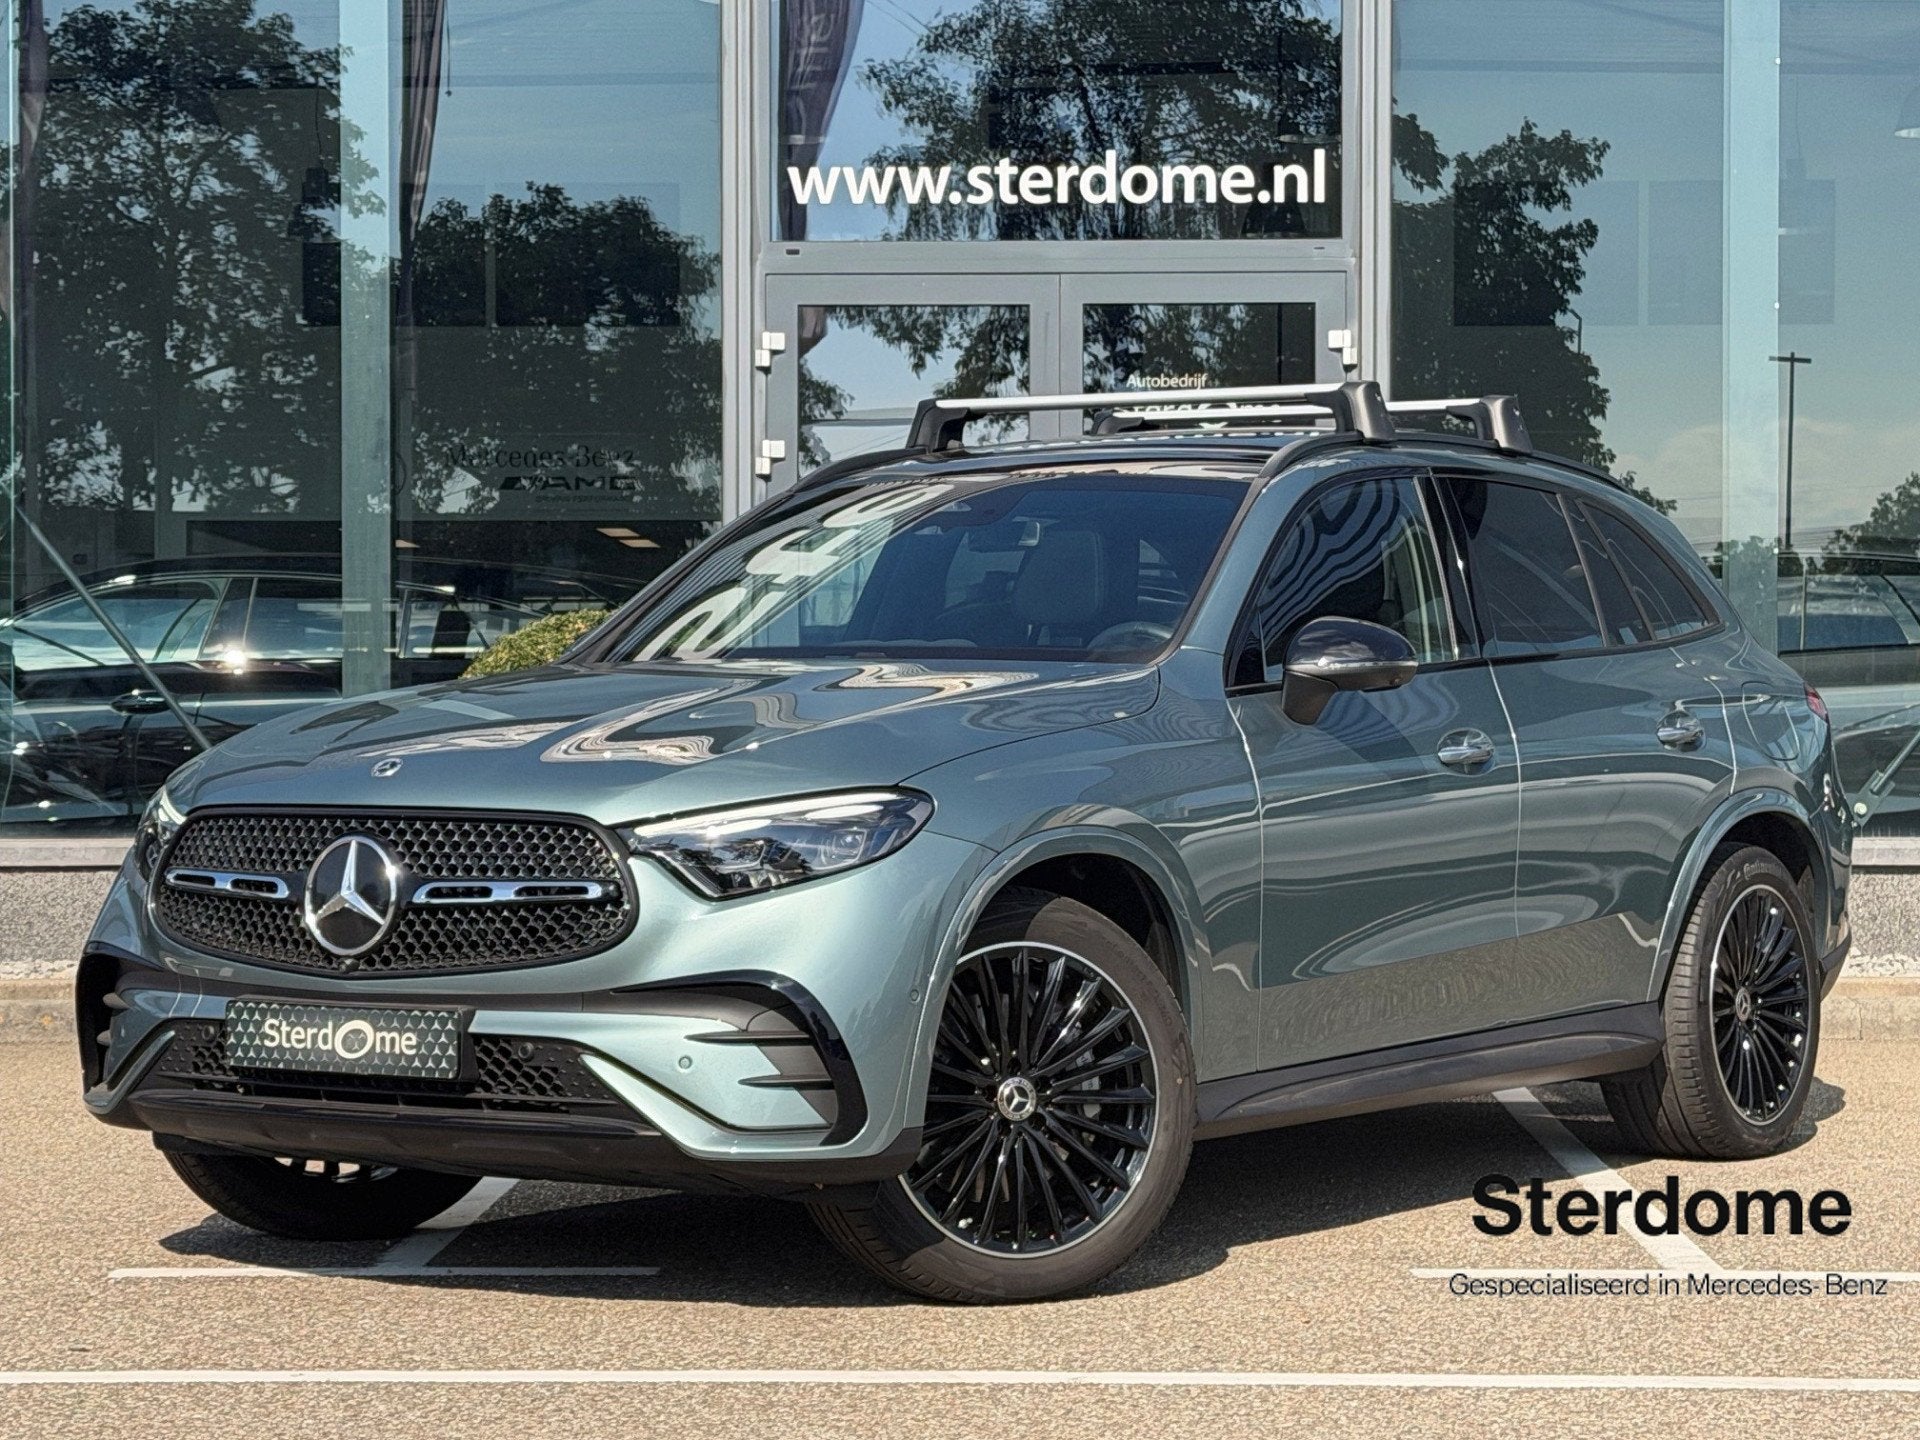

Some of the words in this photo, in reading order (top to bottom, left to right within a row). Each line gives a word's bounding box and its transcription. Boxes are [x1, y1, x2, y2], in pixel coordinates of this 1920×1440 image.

[788, 148, 1327, 206] www.sterdome.nl
[1126, 373, 1209, 391] Autobedrijf
[445, 442, 636, 470] Mcedes-Bez
